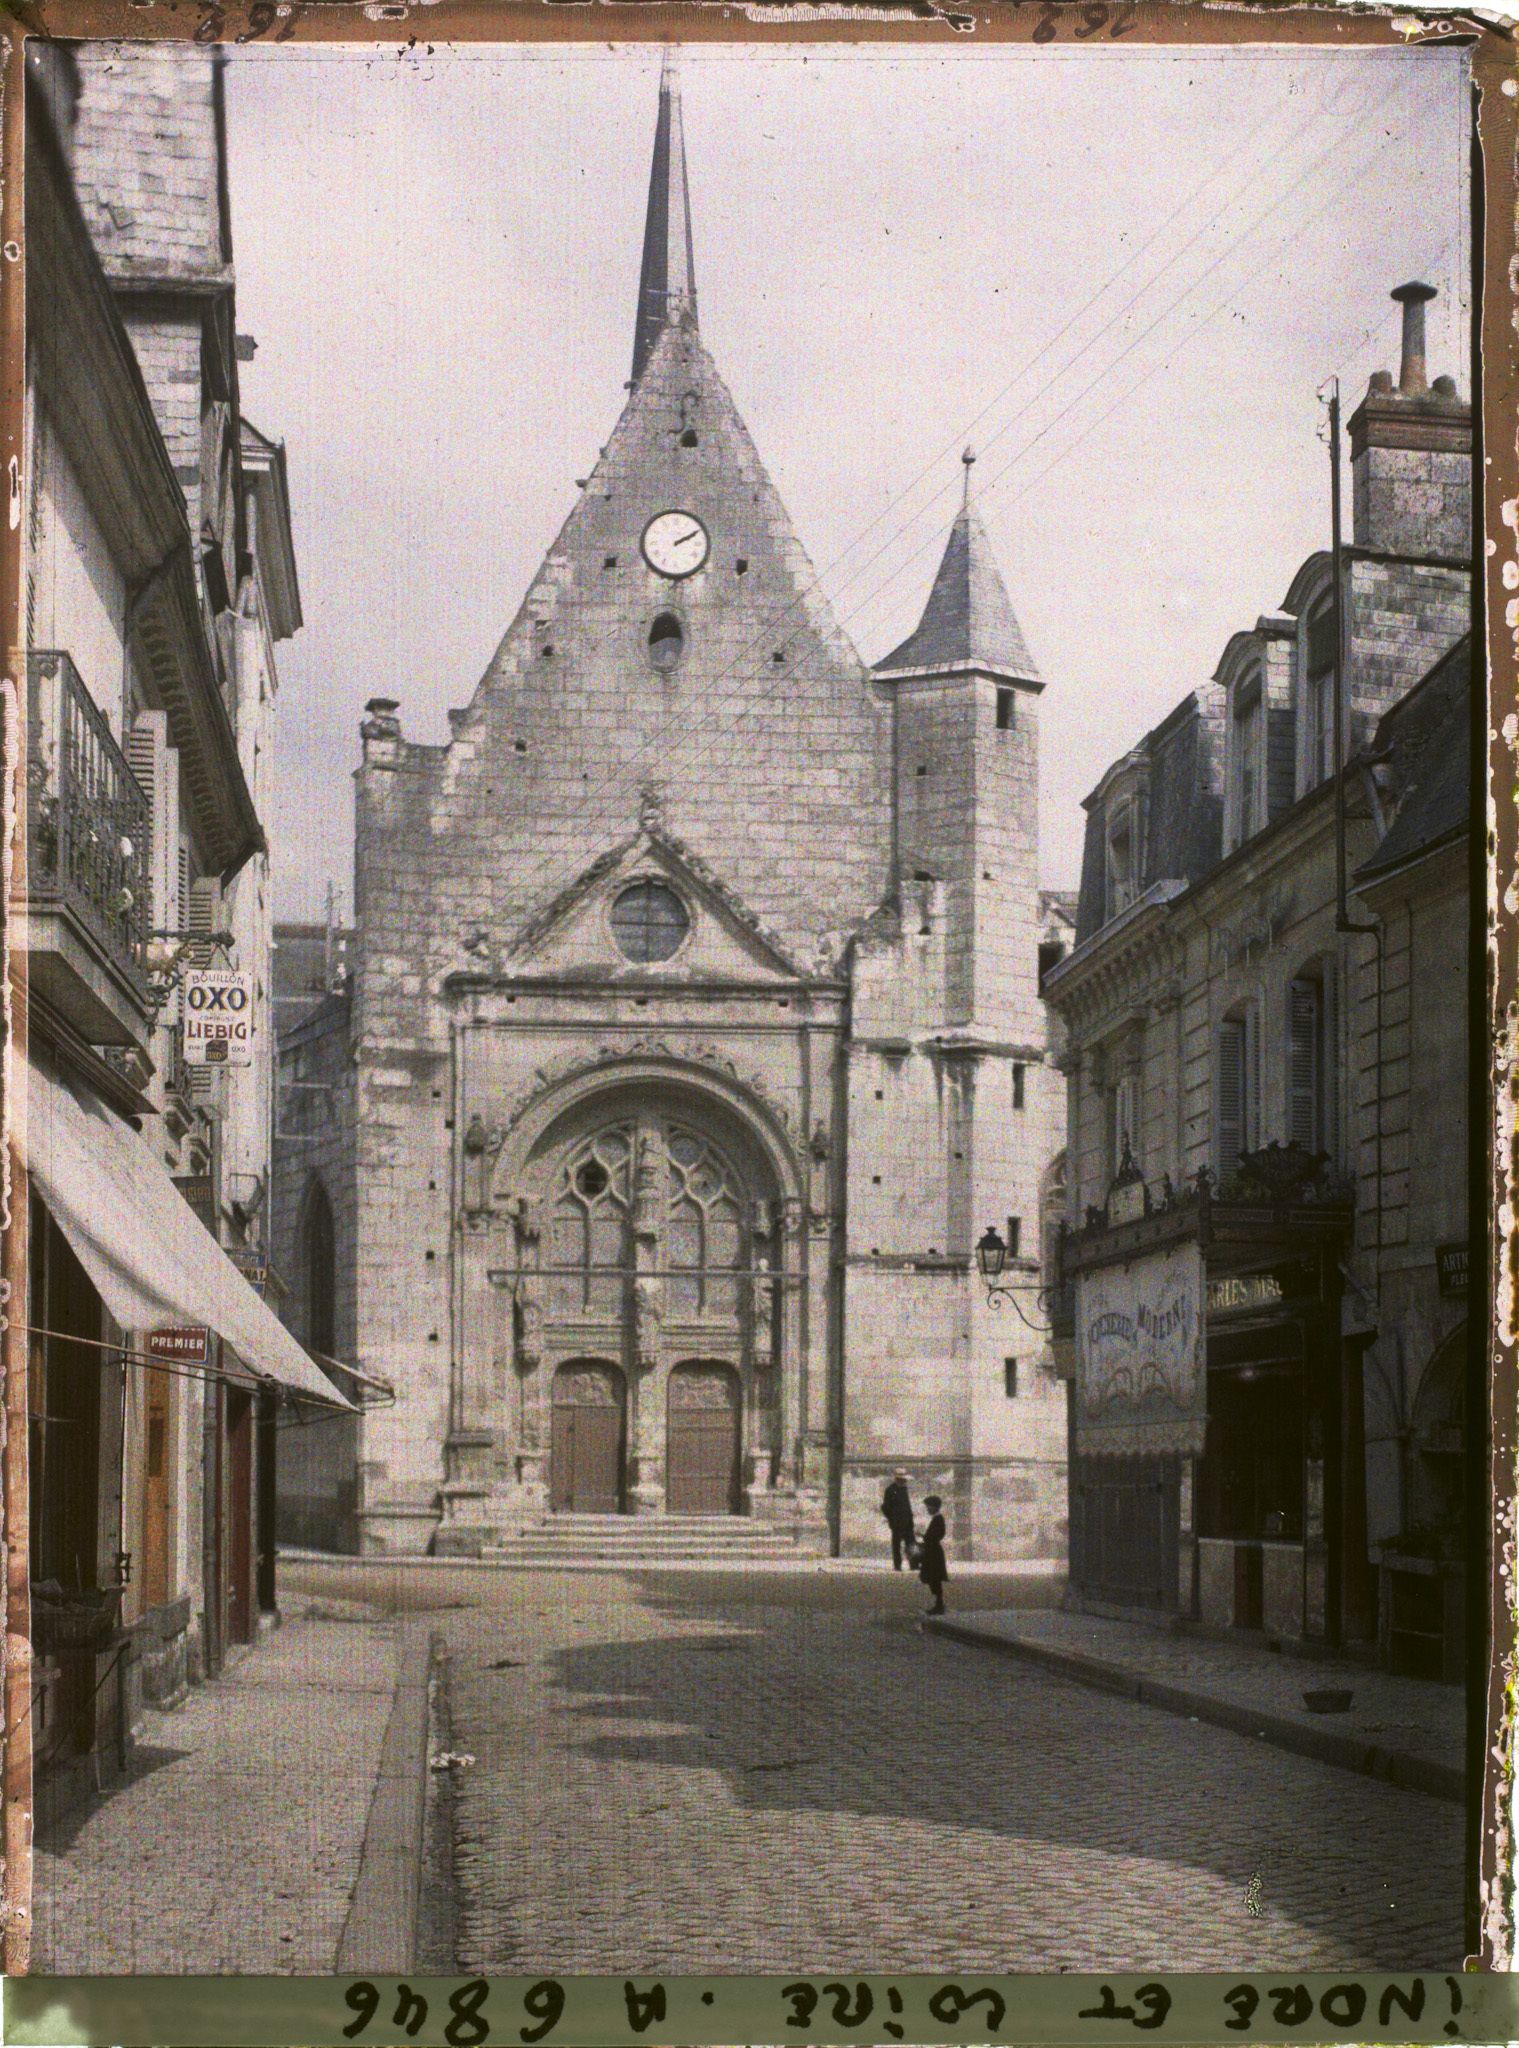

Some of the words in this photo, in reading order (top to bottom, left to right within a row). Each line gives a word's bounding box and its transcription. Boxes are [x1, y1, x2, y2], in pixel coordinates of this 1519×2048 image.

[192, 974, 244, 985] BOUILLON
[188, 986, 248, 1011] OXO
[187, 1020, 247, 1039] LIEBIG
[151, 1336, 204, 1349] PREMIER
[343, 1979, 565, 2044] 6846
[1079, 1983, 1171, 2029] ET
